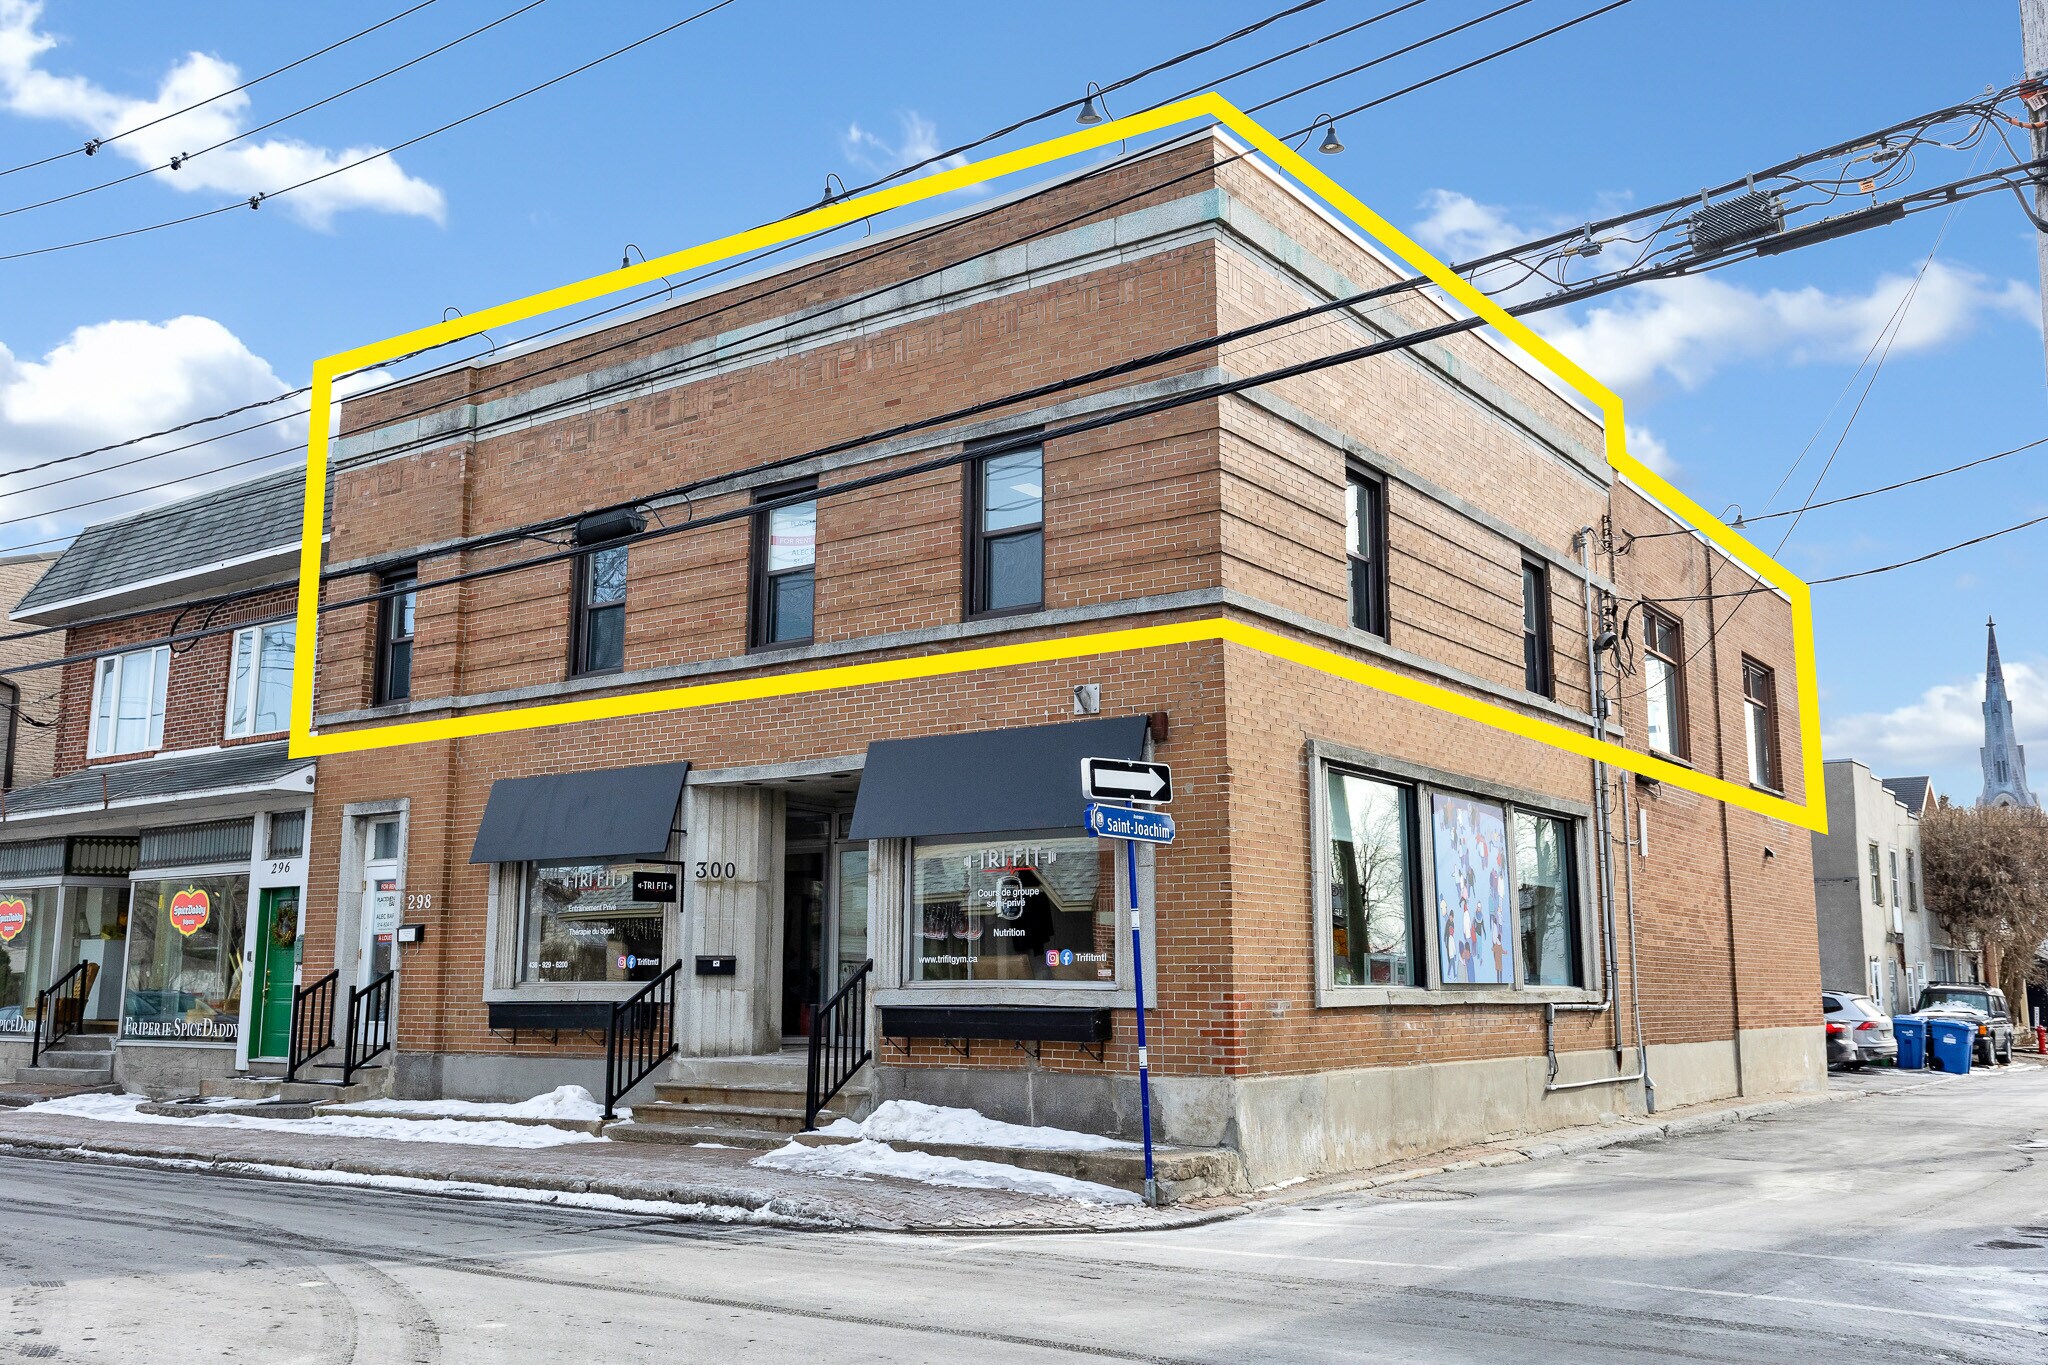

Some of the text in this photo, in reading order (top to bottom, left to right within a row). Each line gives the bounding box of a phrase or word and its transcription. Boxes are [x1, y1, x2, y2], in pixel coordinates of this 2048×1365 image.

[1107, 817, 1170, 839] Saint-Joachim
[979, 846, 1042, 870] TRI FIT
[271, 861, 290, 874] 296
[695, 861, 736, 879] 300
[574, 870, 616, 889] TRI FIT
[643, 880, 668, 891] TRI FIT
[977, 887, 1040, 898] Cours de groupe
[408, 894, 432, 910] 298
[568, 903, 617, 912] Entraînement Privé
[569, 926, 615, 937] Thérapie du Sport
[993, 927, 1026, 937] Nutrition
[918, 953, 978, 966] www.trifitgym.ca
[1075, 953, 1107, 962] Trifitmtl
[124, 1016, 172, 1036] FRIPERIE
